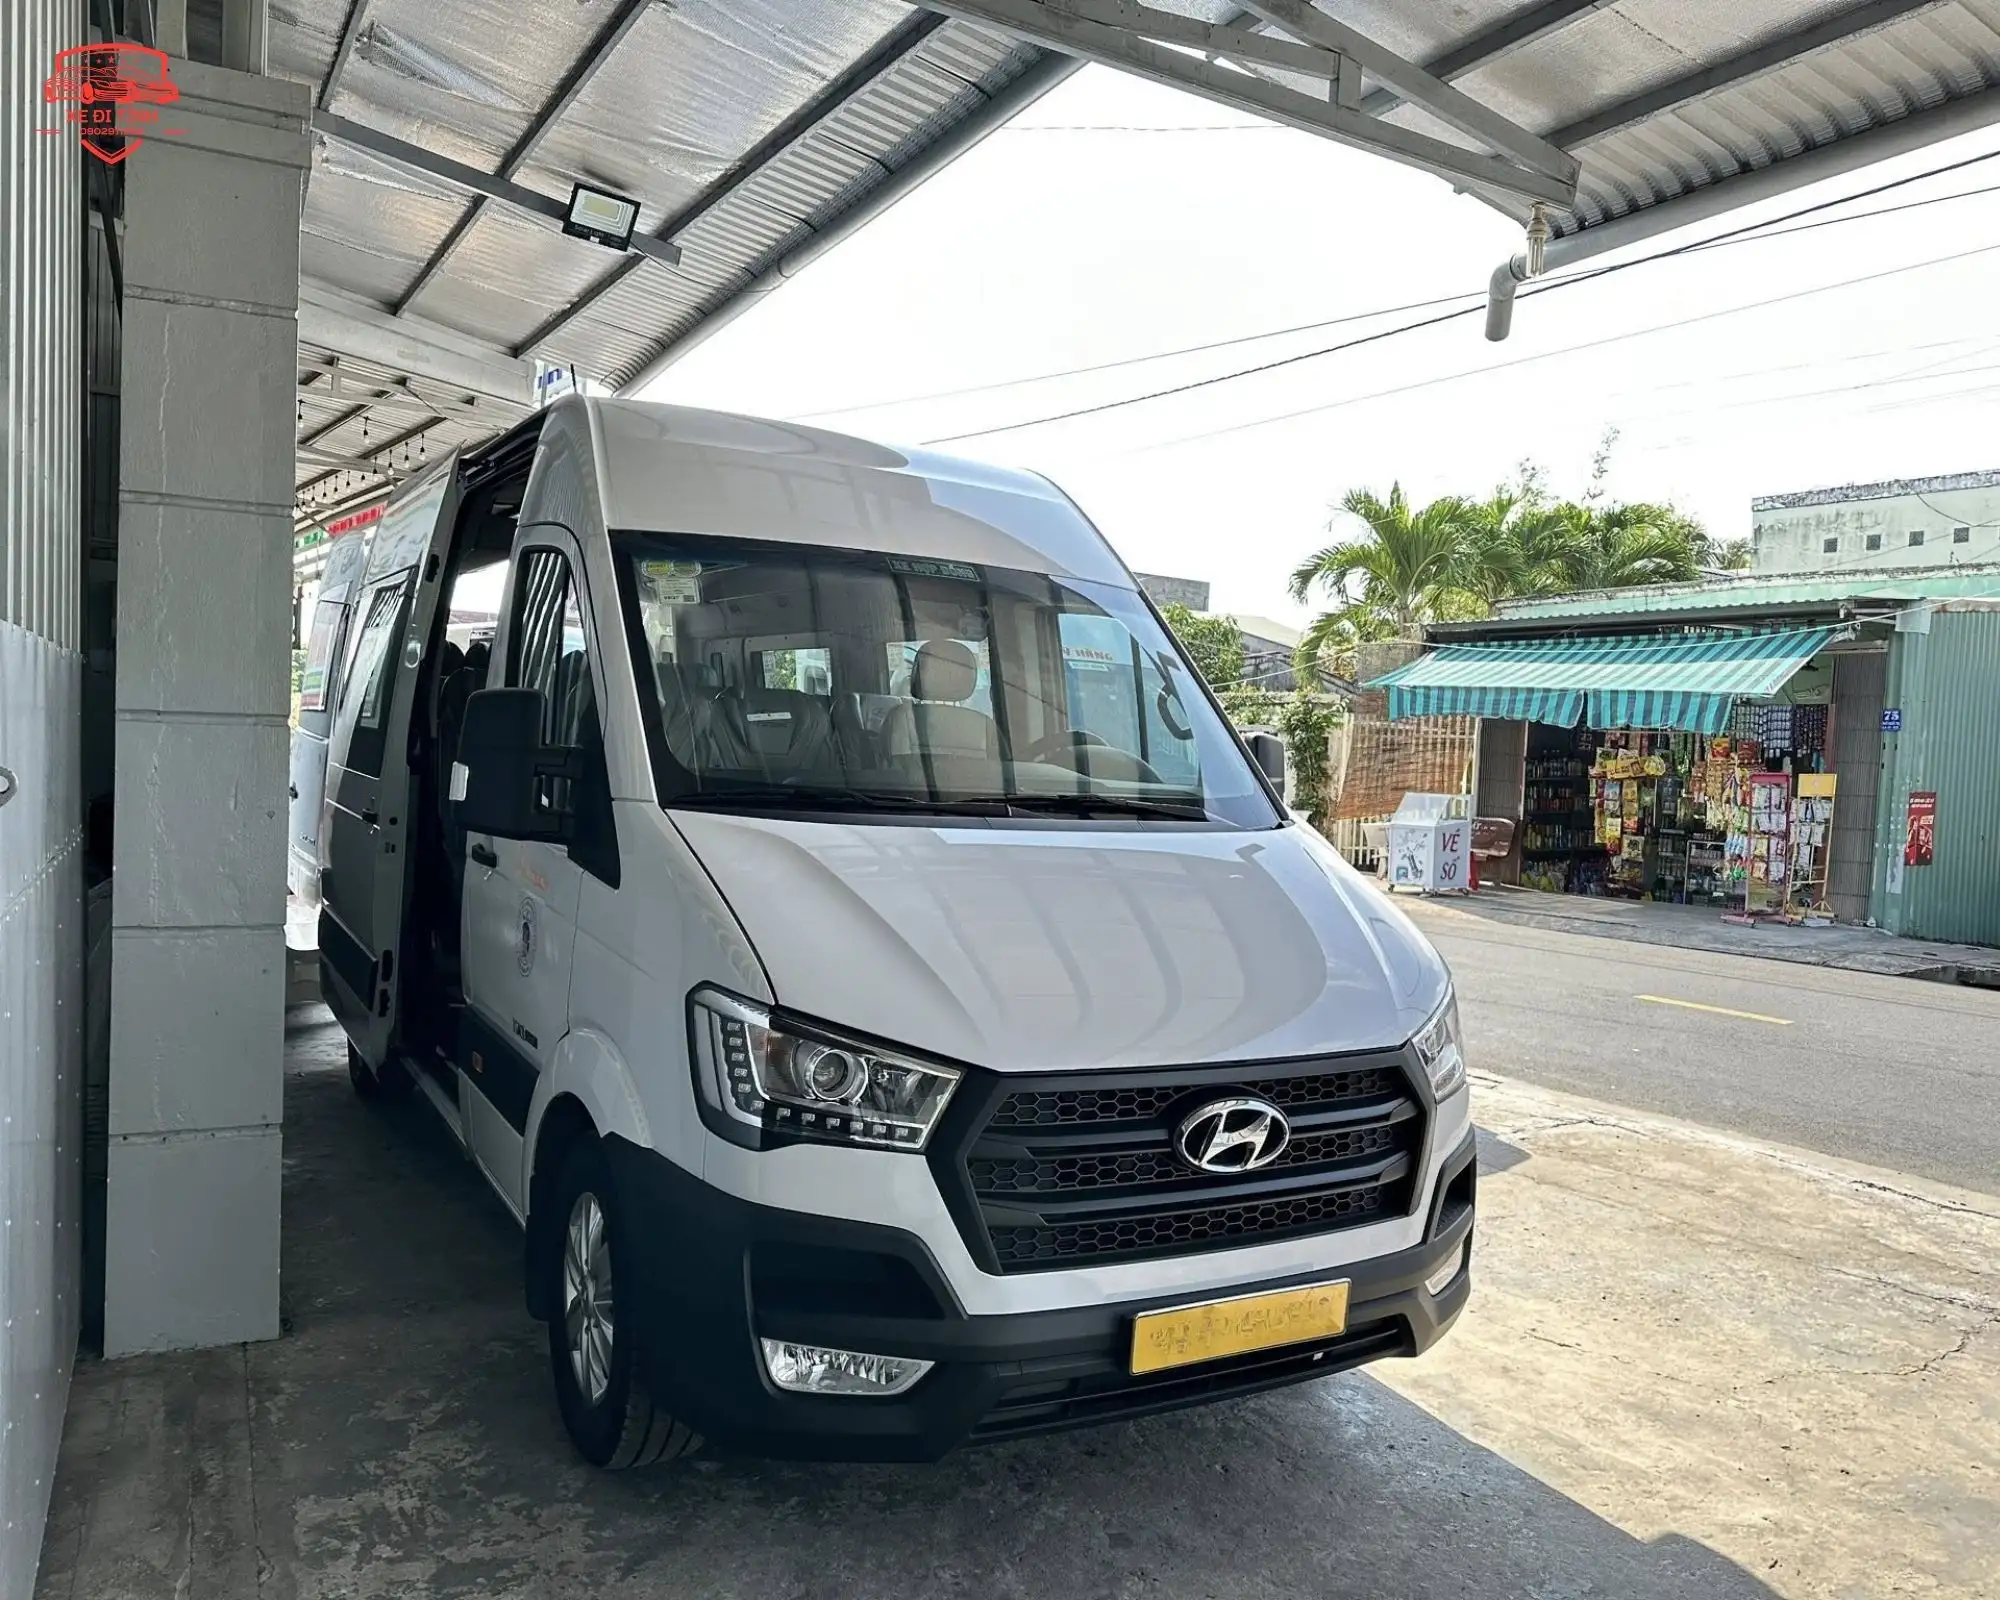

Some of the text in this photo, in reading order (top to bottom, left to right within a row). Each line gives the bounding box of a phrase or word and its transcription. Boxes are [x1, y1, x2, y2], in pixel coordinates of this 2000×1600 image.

[1884, 710, 1900, 721] 75
[1442, 828, 1461, 853] VÉ
[1440, 856, 1461, 881] SỐ
